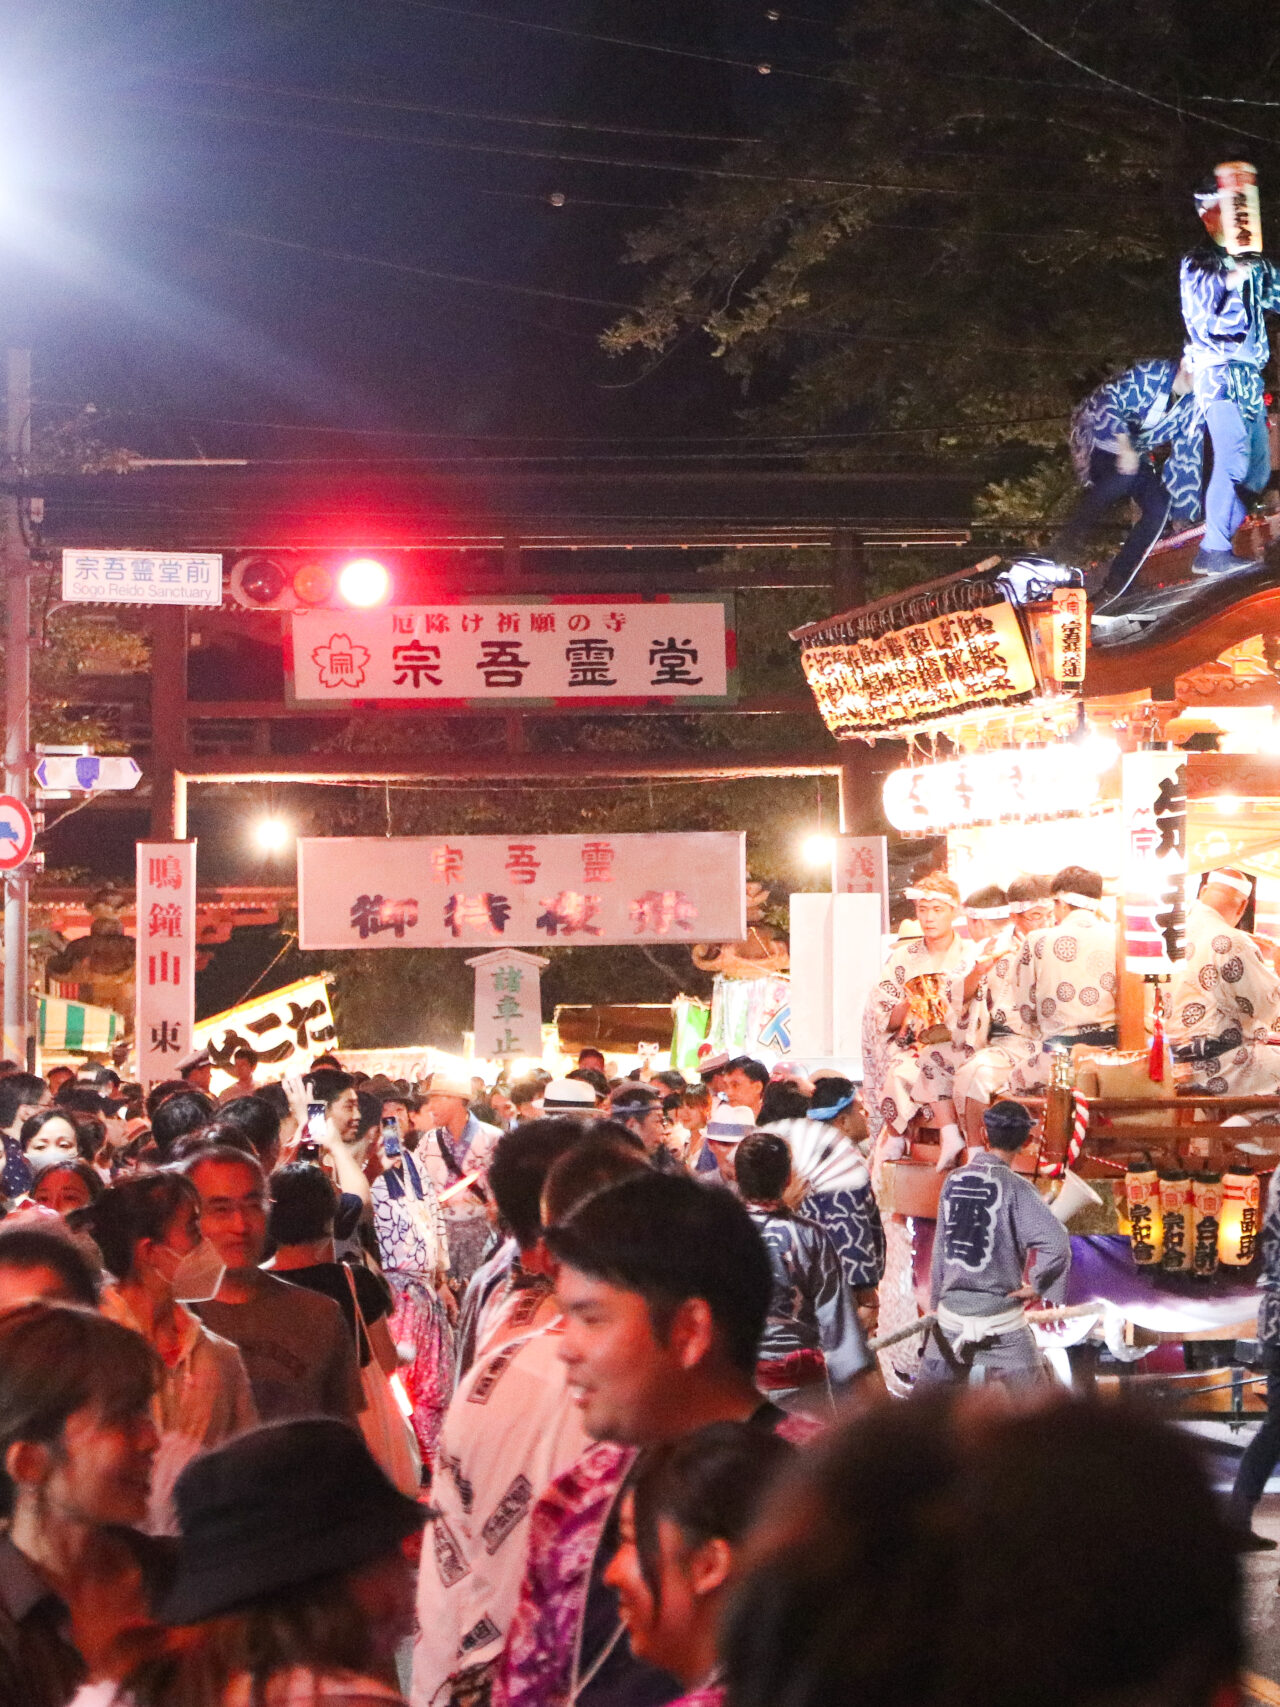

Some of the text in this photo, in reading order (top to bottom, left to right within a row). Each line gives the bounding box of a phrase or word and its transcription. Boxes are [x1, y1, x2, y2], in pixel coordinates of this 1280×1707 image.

[74, 556, 211, 585] 宗吾霊堂前
[73, 583, 212, 600] Sogo Reido Sanctuary
[391, 612, 627, 634] 厄除け祈願の寺
[391, 637, 703, 690] 宗吾霊堂
[148, 855, 184, 986] 鳴鐘山
